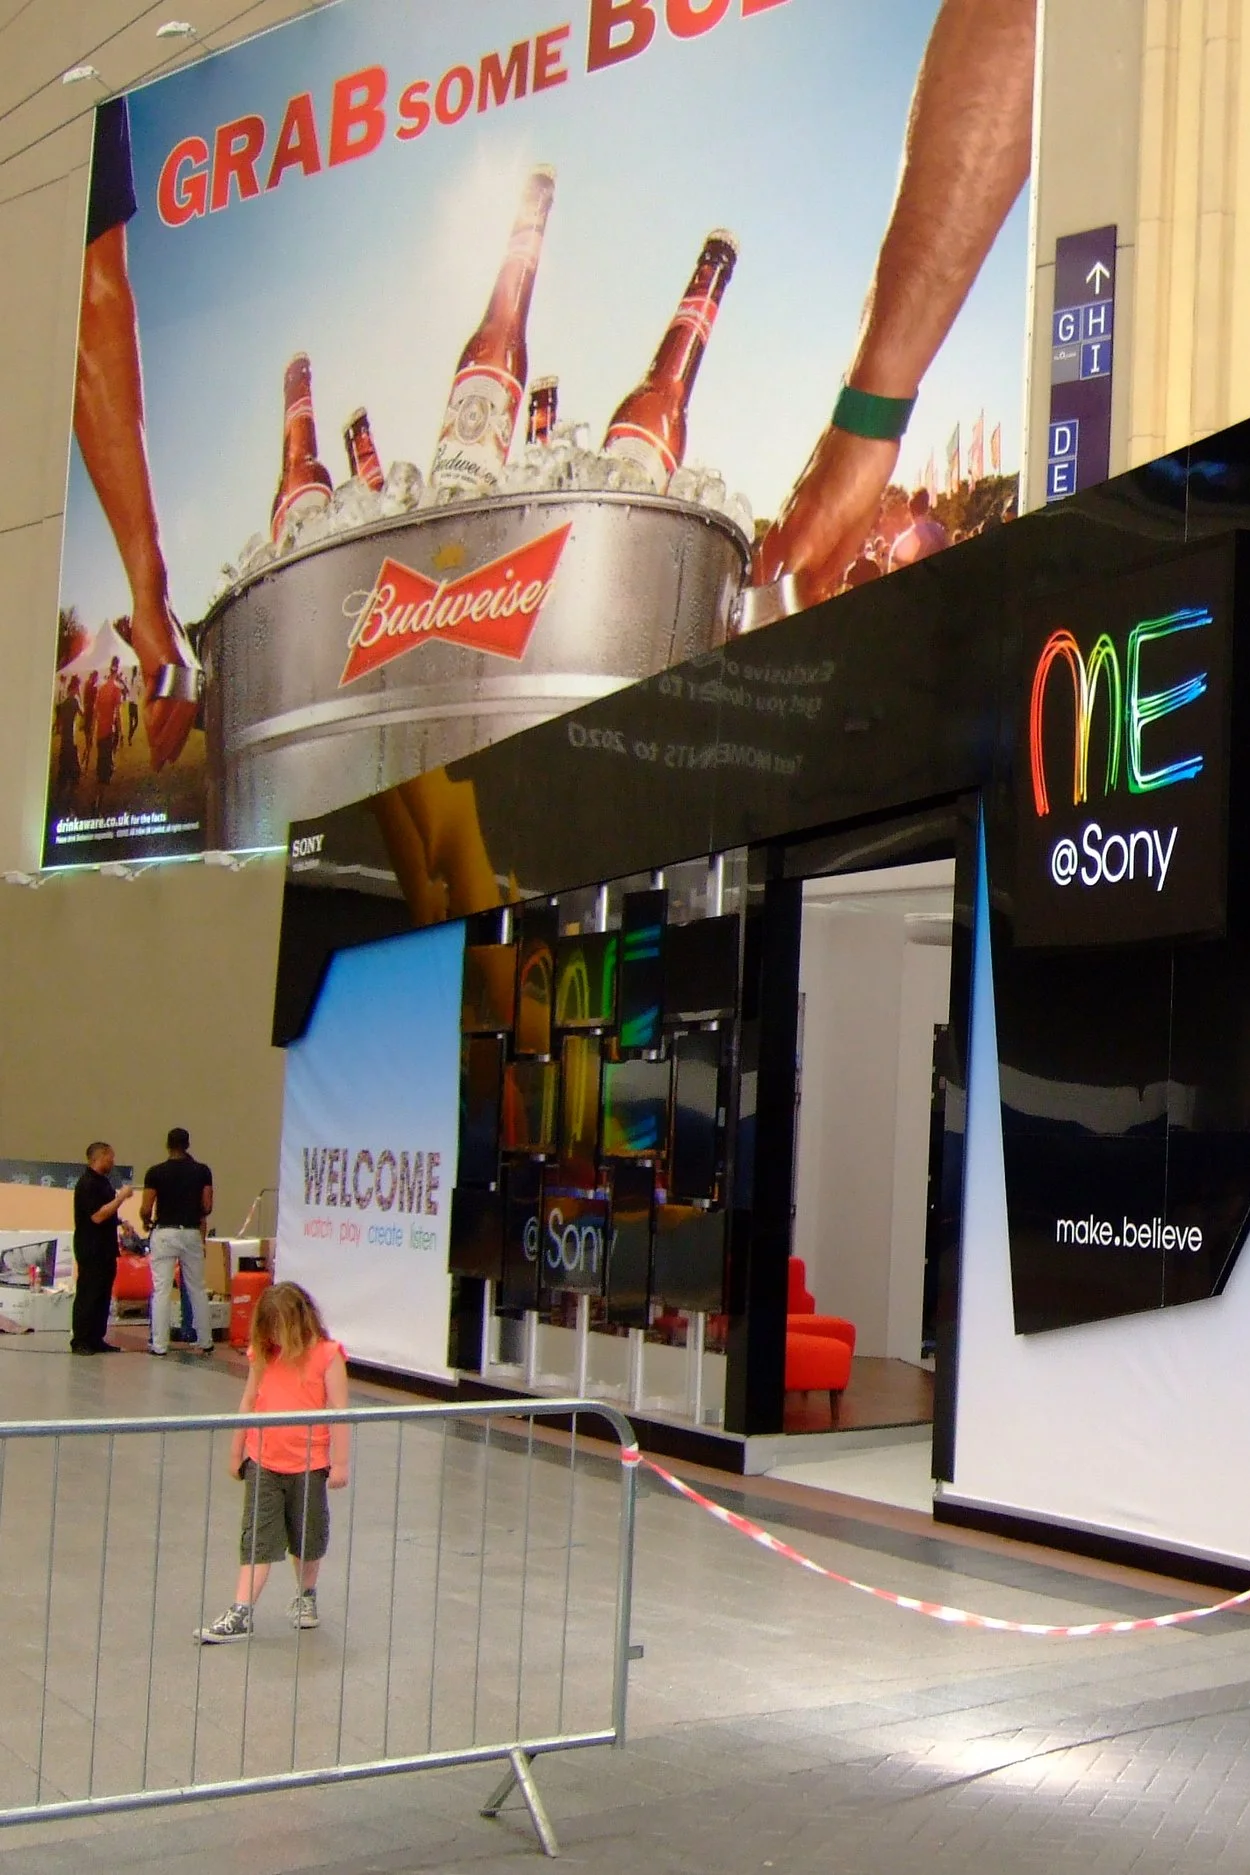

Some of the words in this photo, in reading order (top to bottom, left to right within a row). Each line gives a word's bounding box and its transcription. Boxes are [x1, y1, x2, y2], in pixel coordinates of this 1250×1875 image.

[157, 66, 389, 229] GRAB
[395, 24, 572, 142] SOME
[1058, 313, 1075, 342] G
[1088, 306, 1105, 336] H
[1090, 344, 1101, 374] I
[1055, 426, 1071, 456] D
[1053, 464, 1068, 493] E
[342, 567, 556, 649] Budweiser
[1030, 608, 1214, 817] ME
[292, 834, 325, 858] SONY
[1051, 821, 1179, 891] @Sony
[303, 1147, 442, 1216] WELCOME
[304, 1216, 333, 1239] watch
[339, 1218, 361, 1248] play
[368, 1221, 404, 1248] create
[410, 1220, 437, 1251] listen
[1056, 1213, 1203, 1252] make.believe
